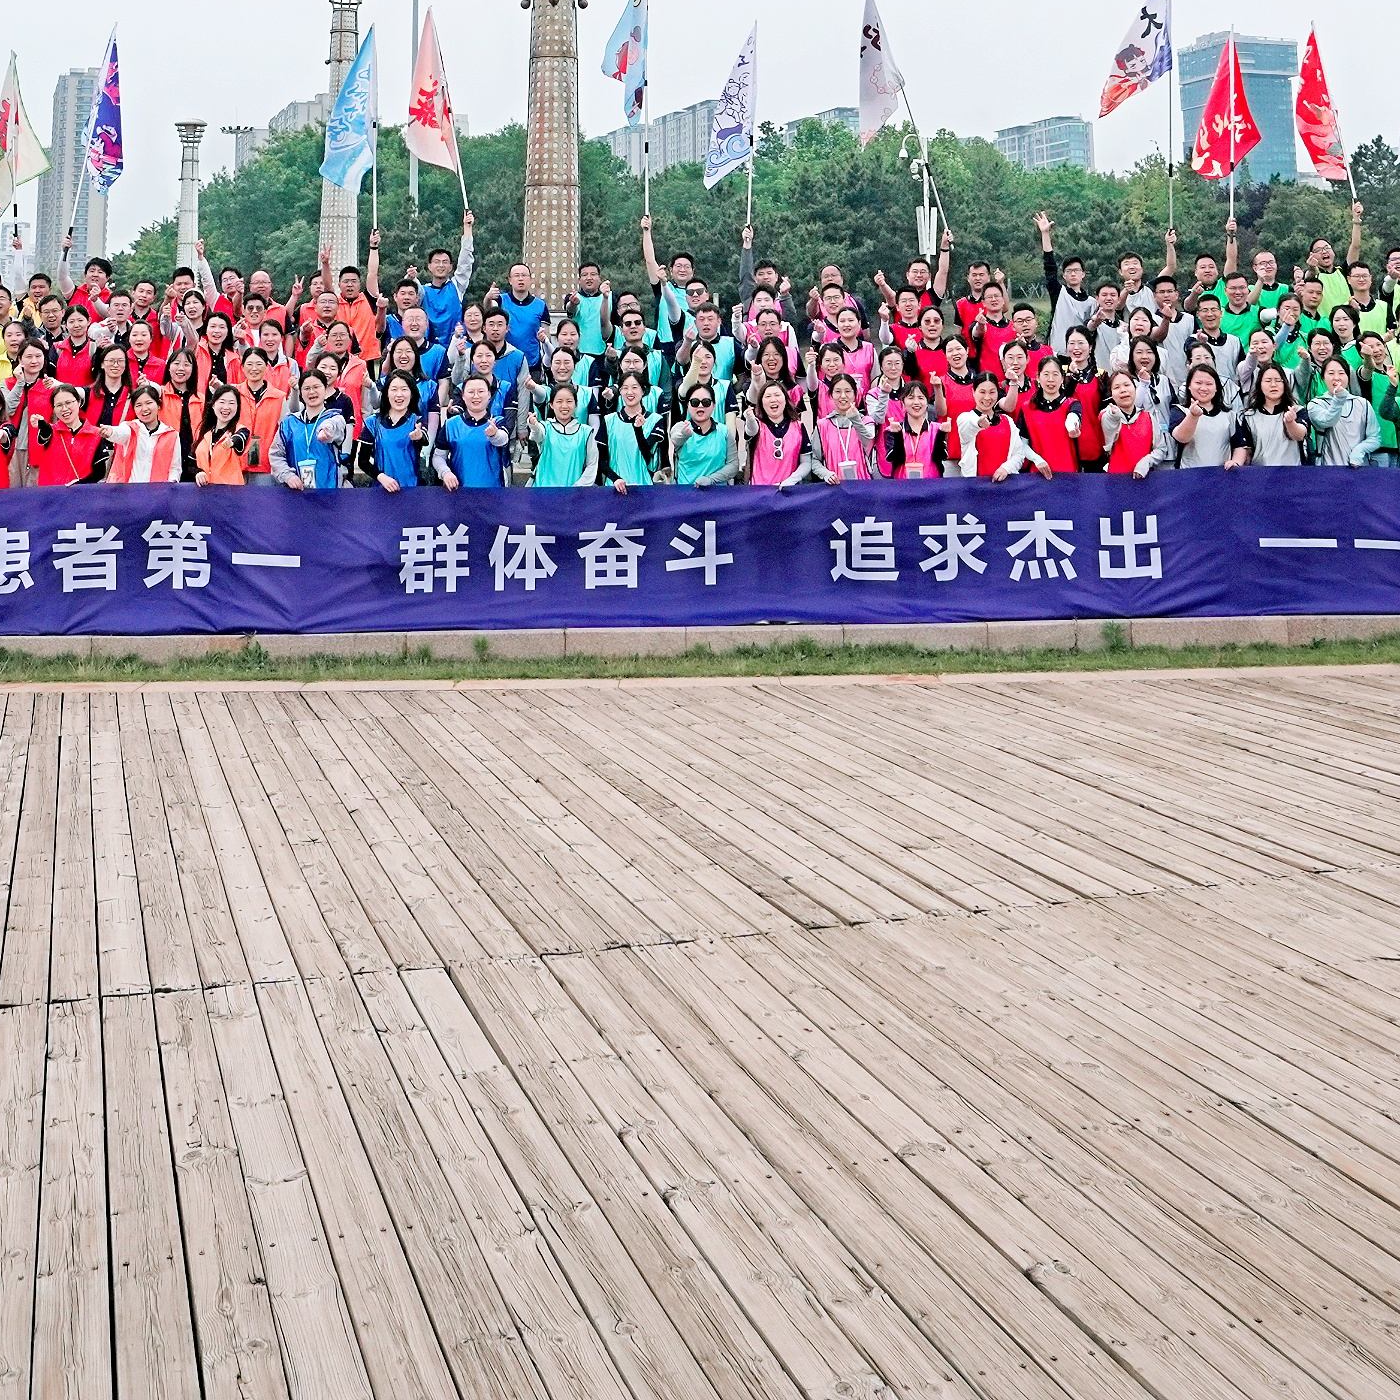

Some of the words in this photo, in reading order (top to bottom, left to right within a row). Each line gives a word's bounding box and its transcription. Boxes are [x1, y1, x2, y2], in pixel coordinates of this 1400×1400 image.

[398, 520, 734, 594] 群体奋斗
[829, 510, 1163, 582] 追求杰出
